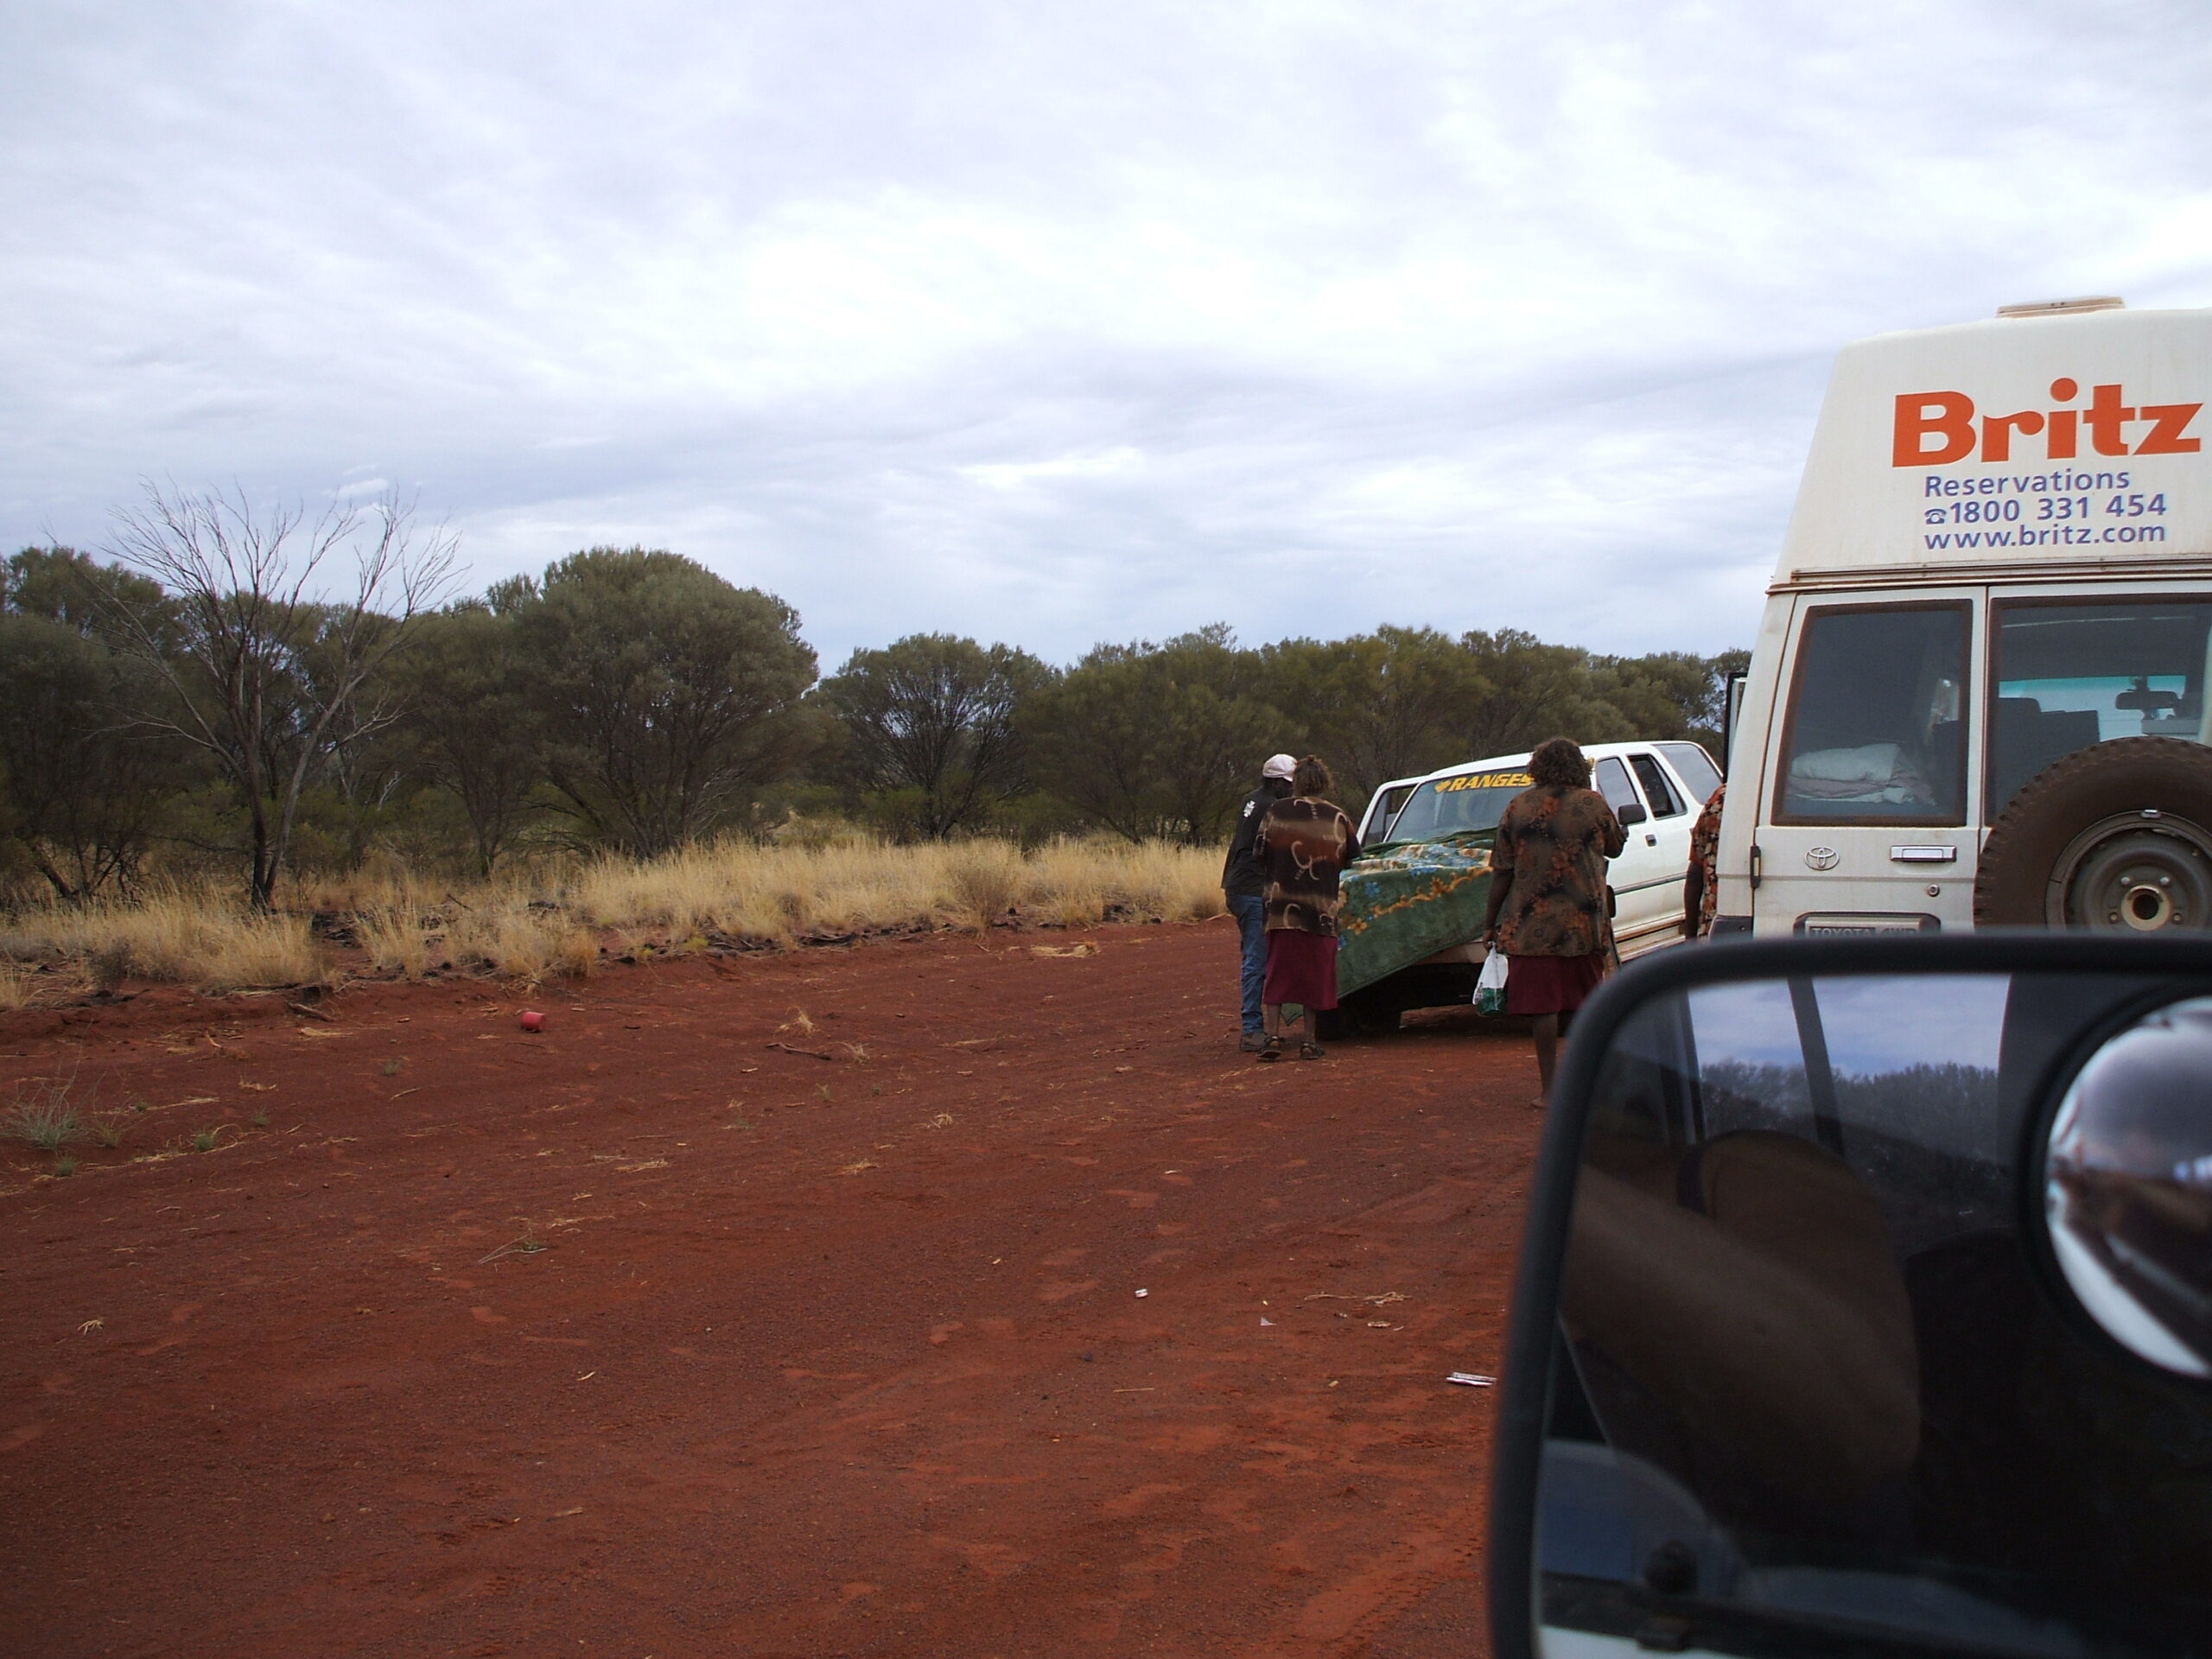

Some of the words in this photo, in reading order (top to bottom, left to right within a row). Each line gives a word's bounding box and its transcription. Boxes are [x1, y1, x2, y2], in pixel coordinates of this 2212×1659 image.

[1891, 377, 2204, 467] Britz
[1923, 467, 2131, 499] Reservations
[1948, 499, 2021, 524] 1800
[2036, 496, 2088, 521] 331
[2105, 493, 2167, 518] 454
[1923, 523, 2166, 550] www.britz.com
